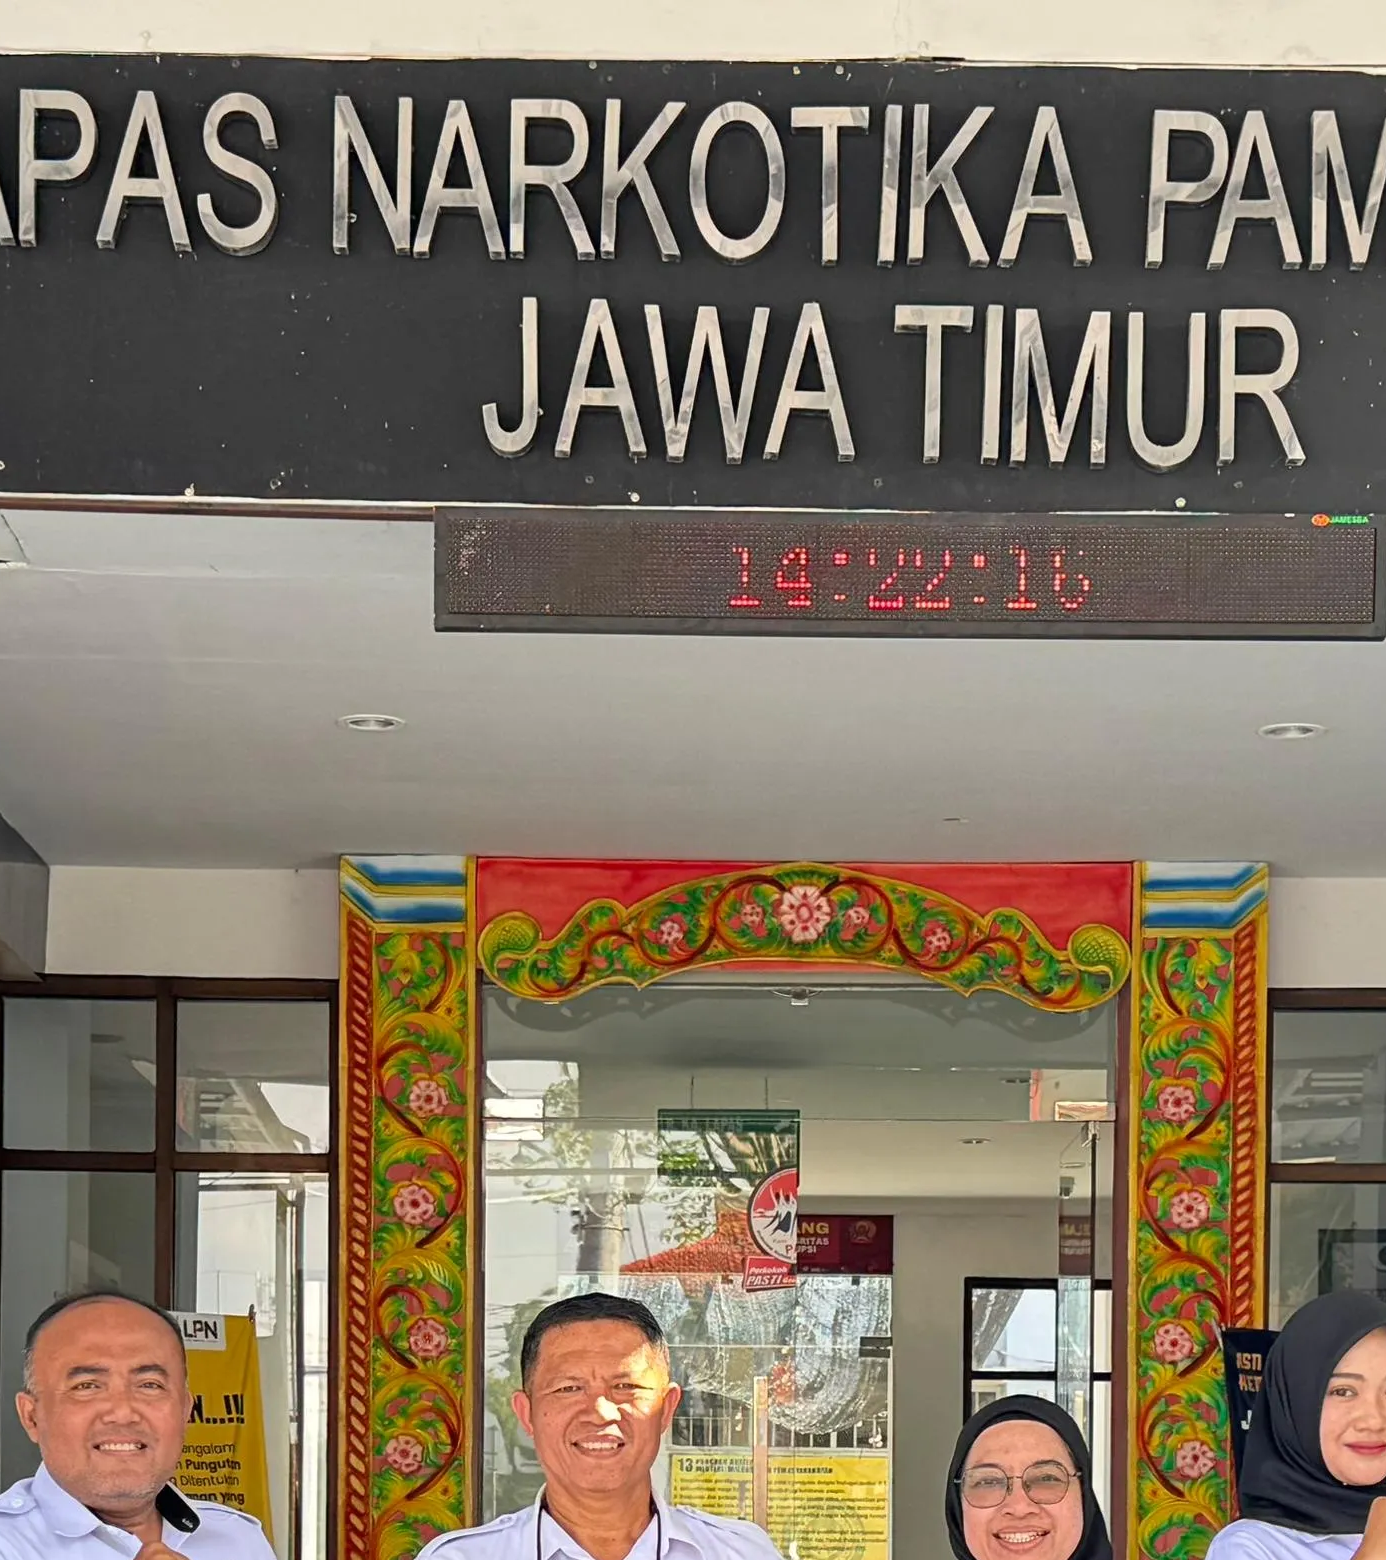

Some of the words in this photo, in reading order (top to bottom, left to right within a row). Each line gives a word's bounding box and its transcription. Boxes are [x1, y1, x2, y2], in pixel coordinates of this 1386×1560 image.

[333, 95, 1092, 269] NARKOTIKA
[482, 297, 854, 465] JAWA
[894, 304, 1306, 473] TIMUR
[729, 546, 1093, 611] 14:22:16
[747, 1274, 782, 1286] PASTI
[678, 1458, 693, 1472] 13
